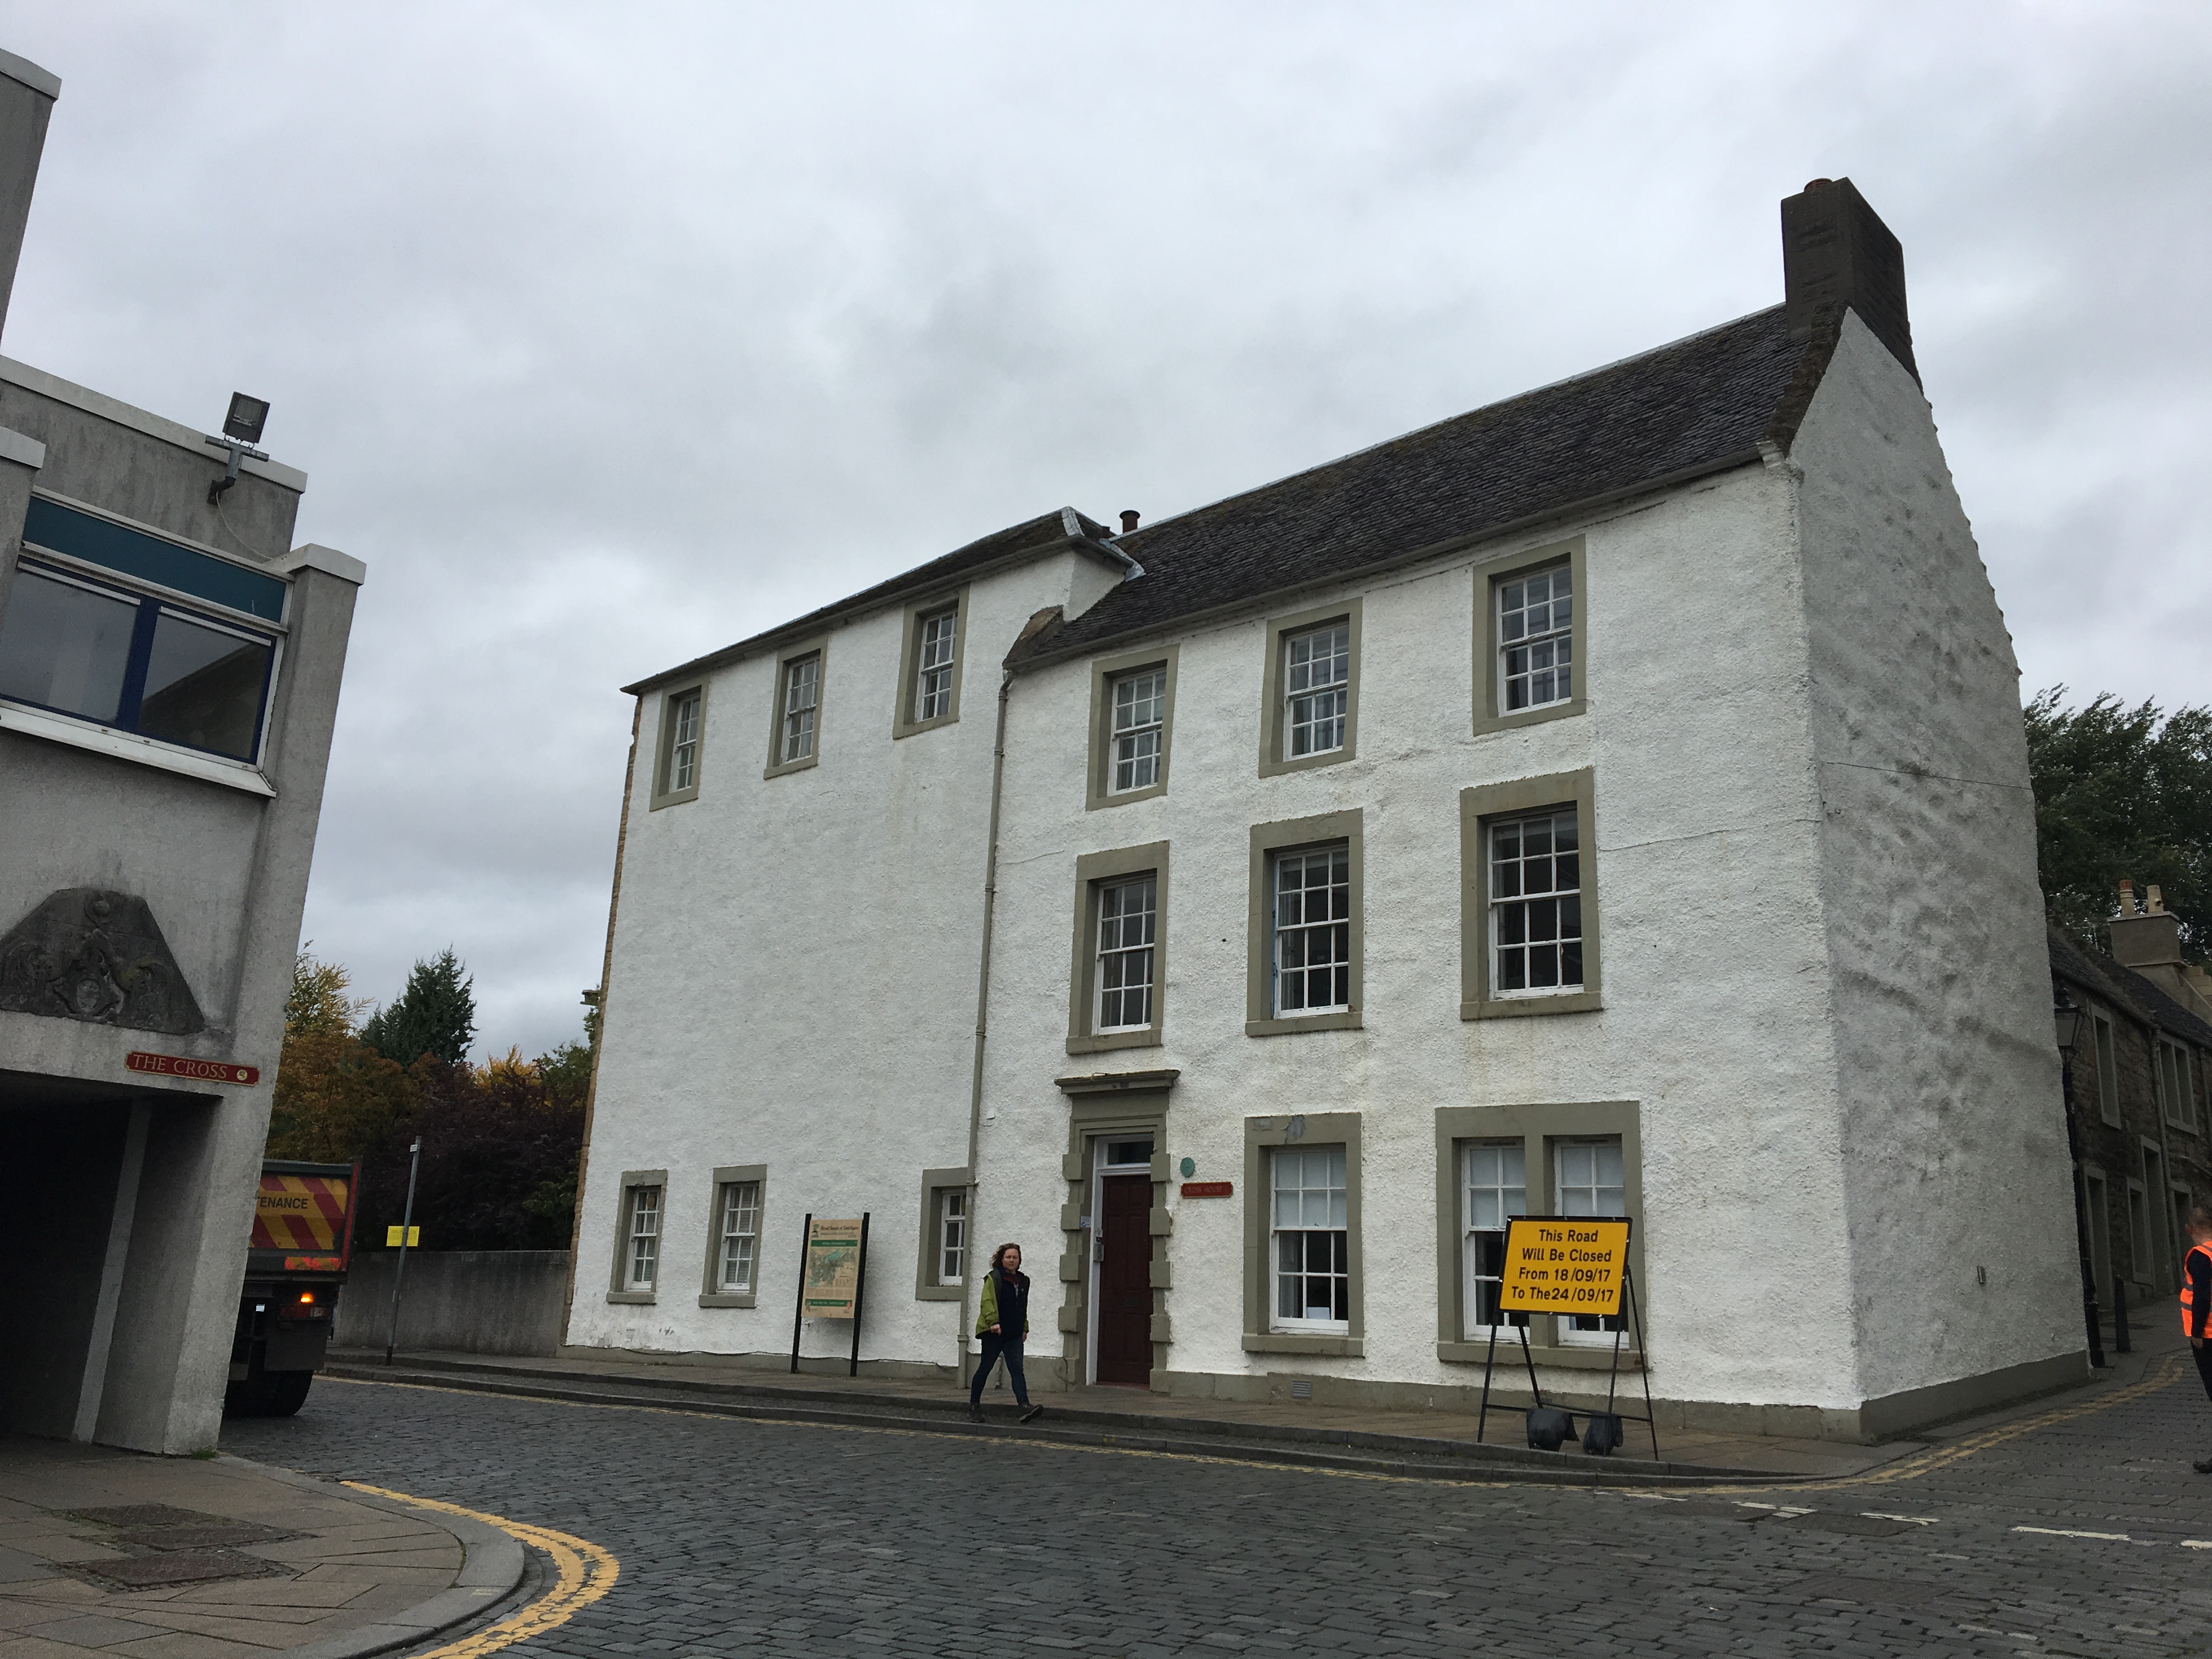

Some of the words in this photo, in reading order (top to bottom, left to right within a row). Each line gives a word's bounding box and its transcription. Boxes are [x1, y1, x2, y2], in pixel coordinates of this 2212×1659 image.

[133, 1054, 167, 1070] THE
[173, 1060, 227, 1079] CROSS
[1539, 1229, 1562, 1242] This
[1567, 1229, 1599, 1243] Road
[1522, 1248, 1544, 1261] Will
[1549, 1249, 1565, 1261] Be
[1570, 1249, 1612, 1262] Closed
[1519, 1267, 1549, 1280] From
[1512, 1286, 1525, 1299] To
